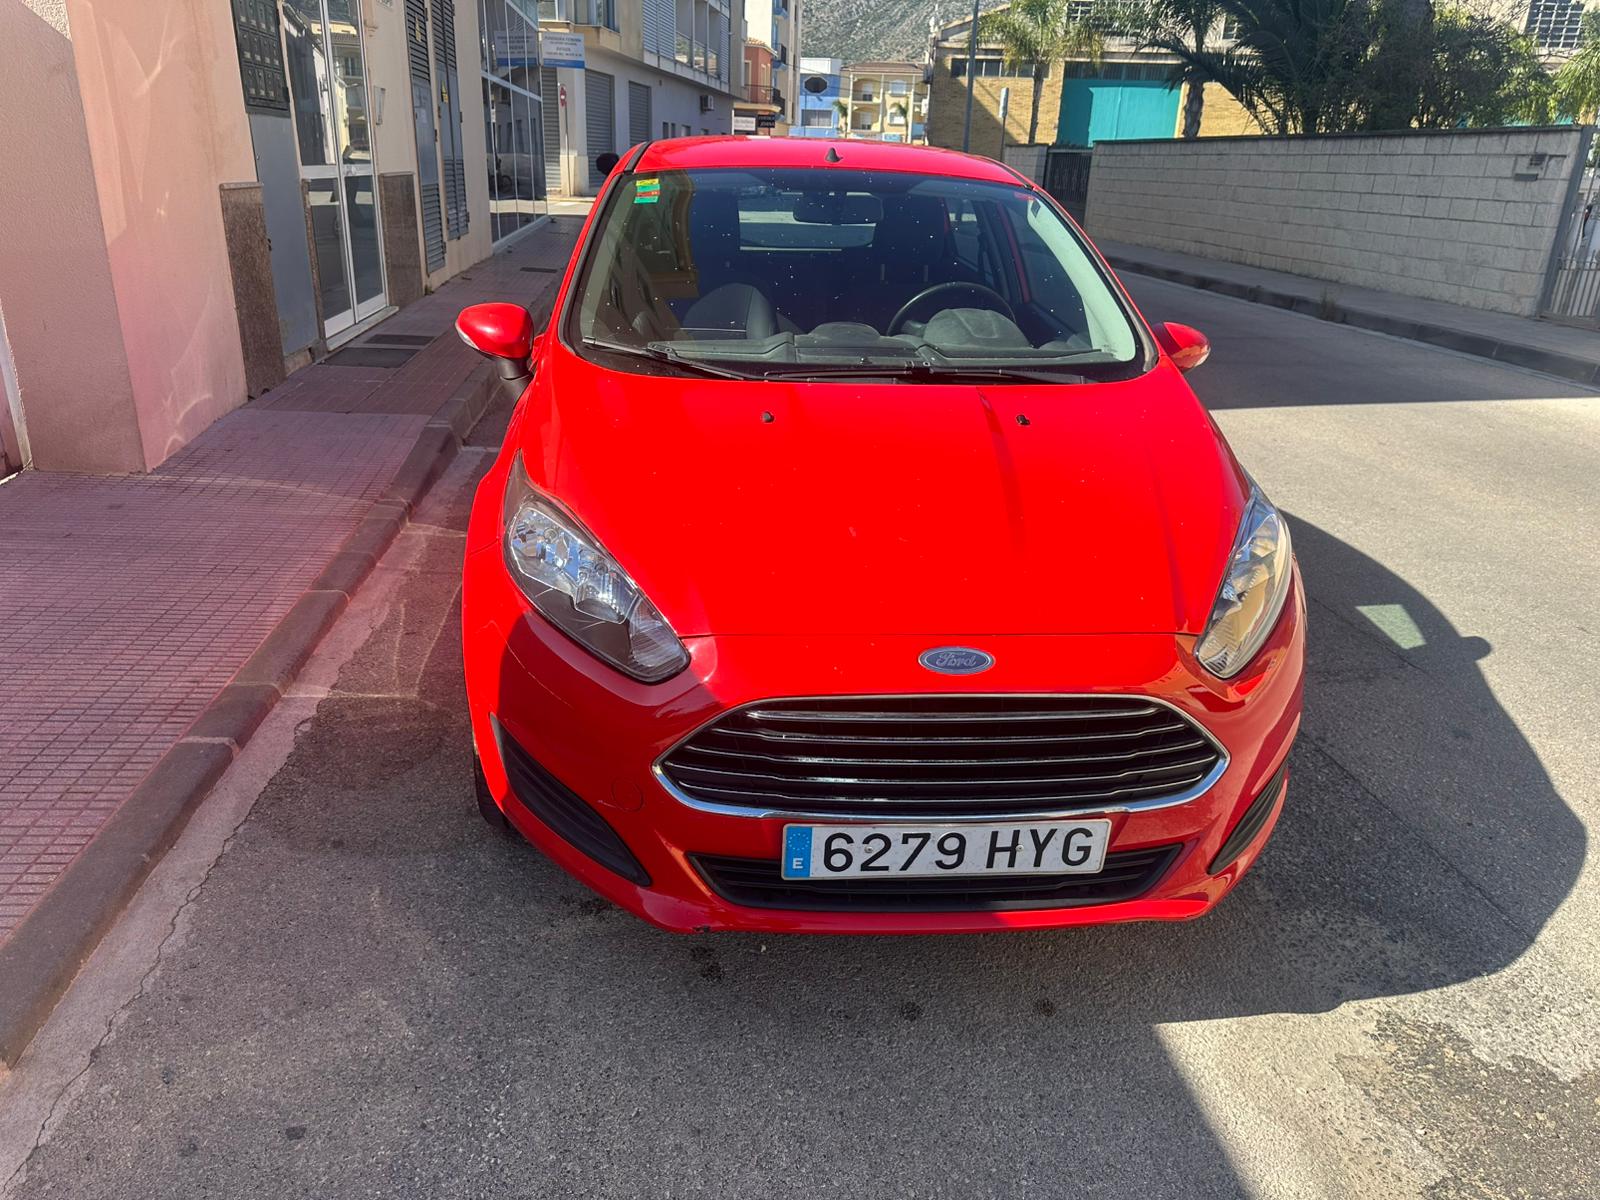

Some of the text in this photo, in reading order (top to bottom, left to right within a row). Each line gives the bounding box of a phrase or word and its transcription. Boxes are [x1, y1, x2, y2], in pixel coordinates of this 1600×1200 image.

[935, 652, 977, 667] Ford
[792, 827, 1094, 872] E 6279 HYG
